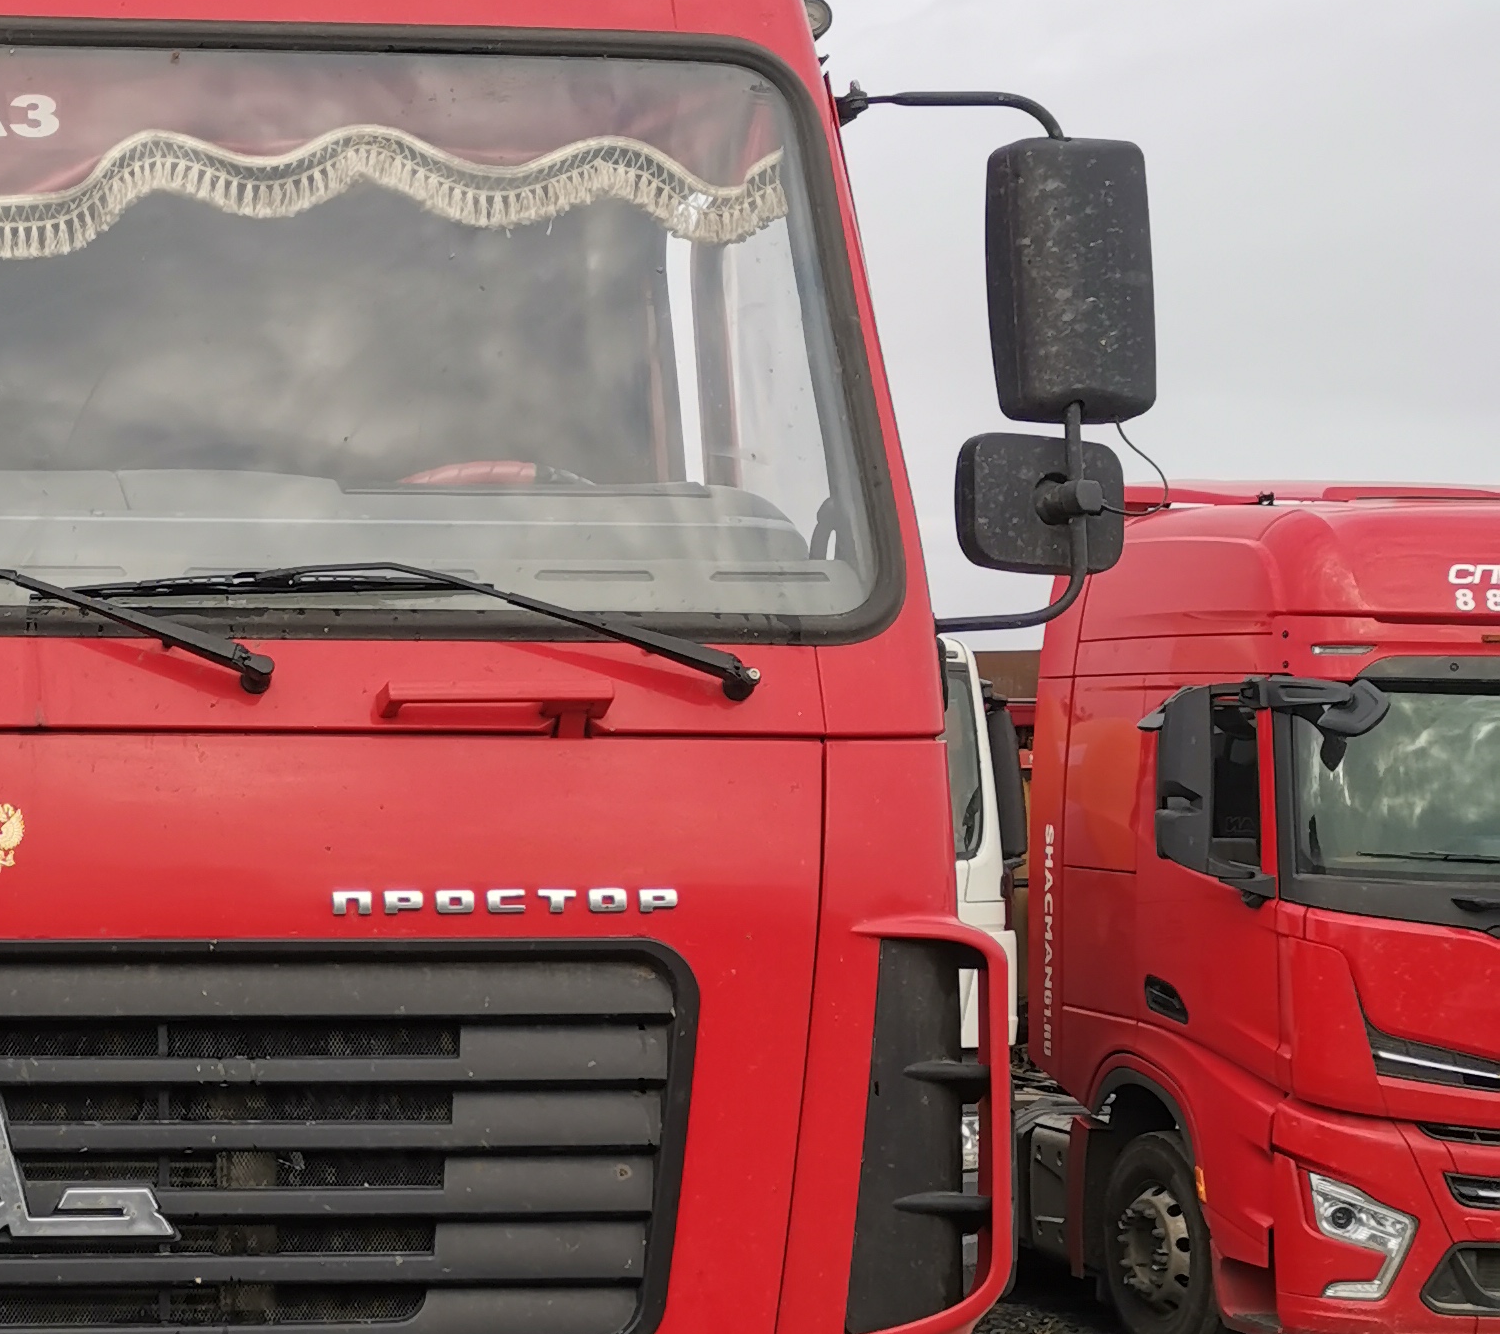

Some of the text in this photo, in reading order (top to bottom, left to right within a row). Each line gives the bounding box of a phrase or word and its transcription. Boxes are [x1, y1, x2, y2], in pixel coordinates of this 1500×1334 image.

[1448, 563, 1500, 584] СП
[1455, 588, 1476, 611] 8
[332, 888, 678, 916] ПРОСТОР
